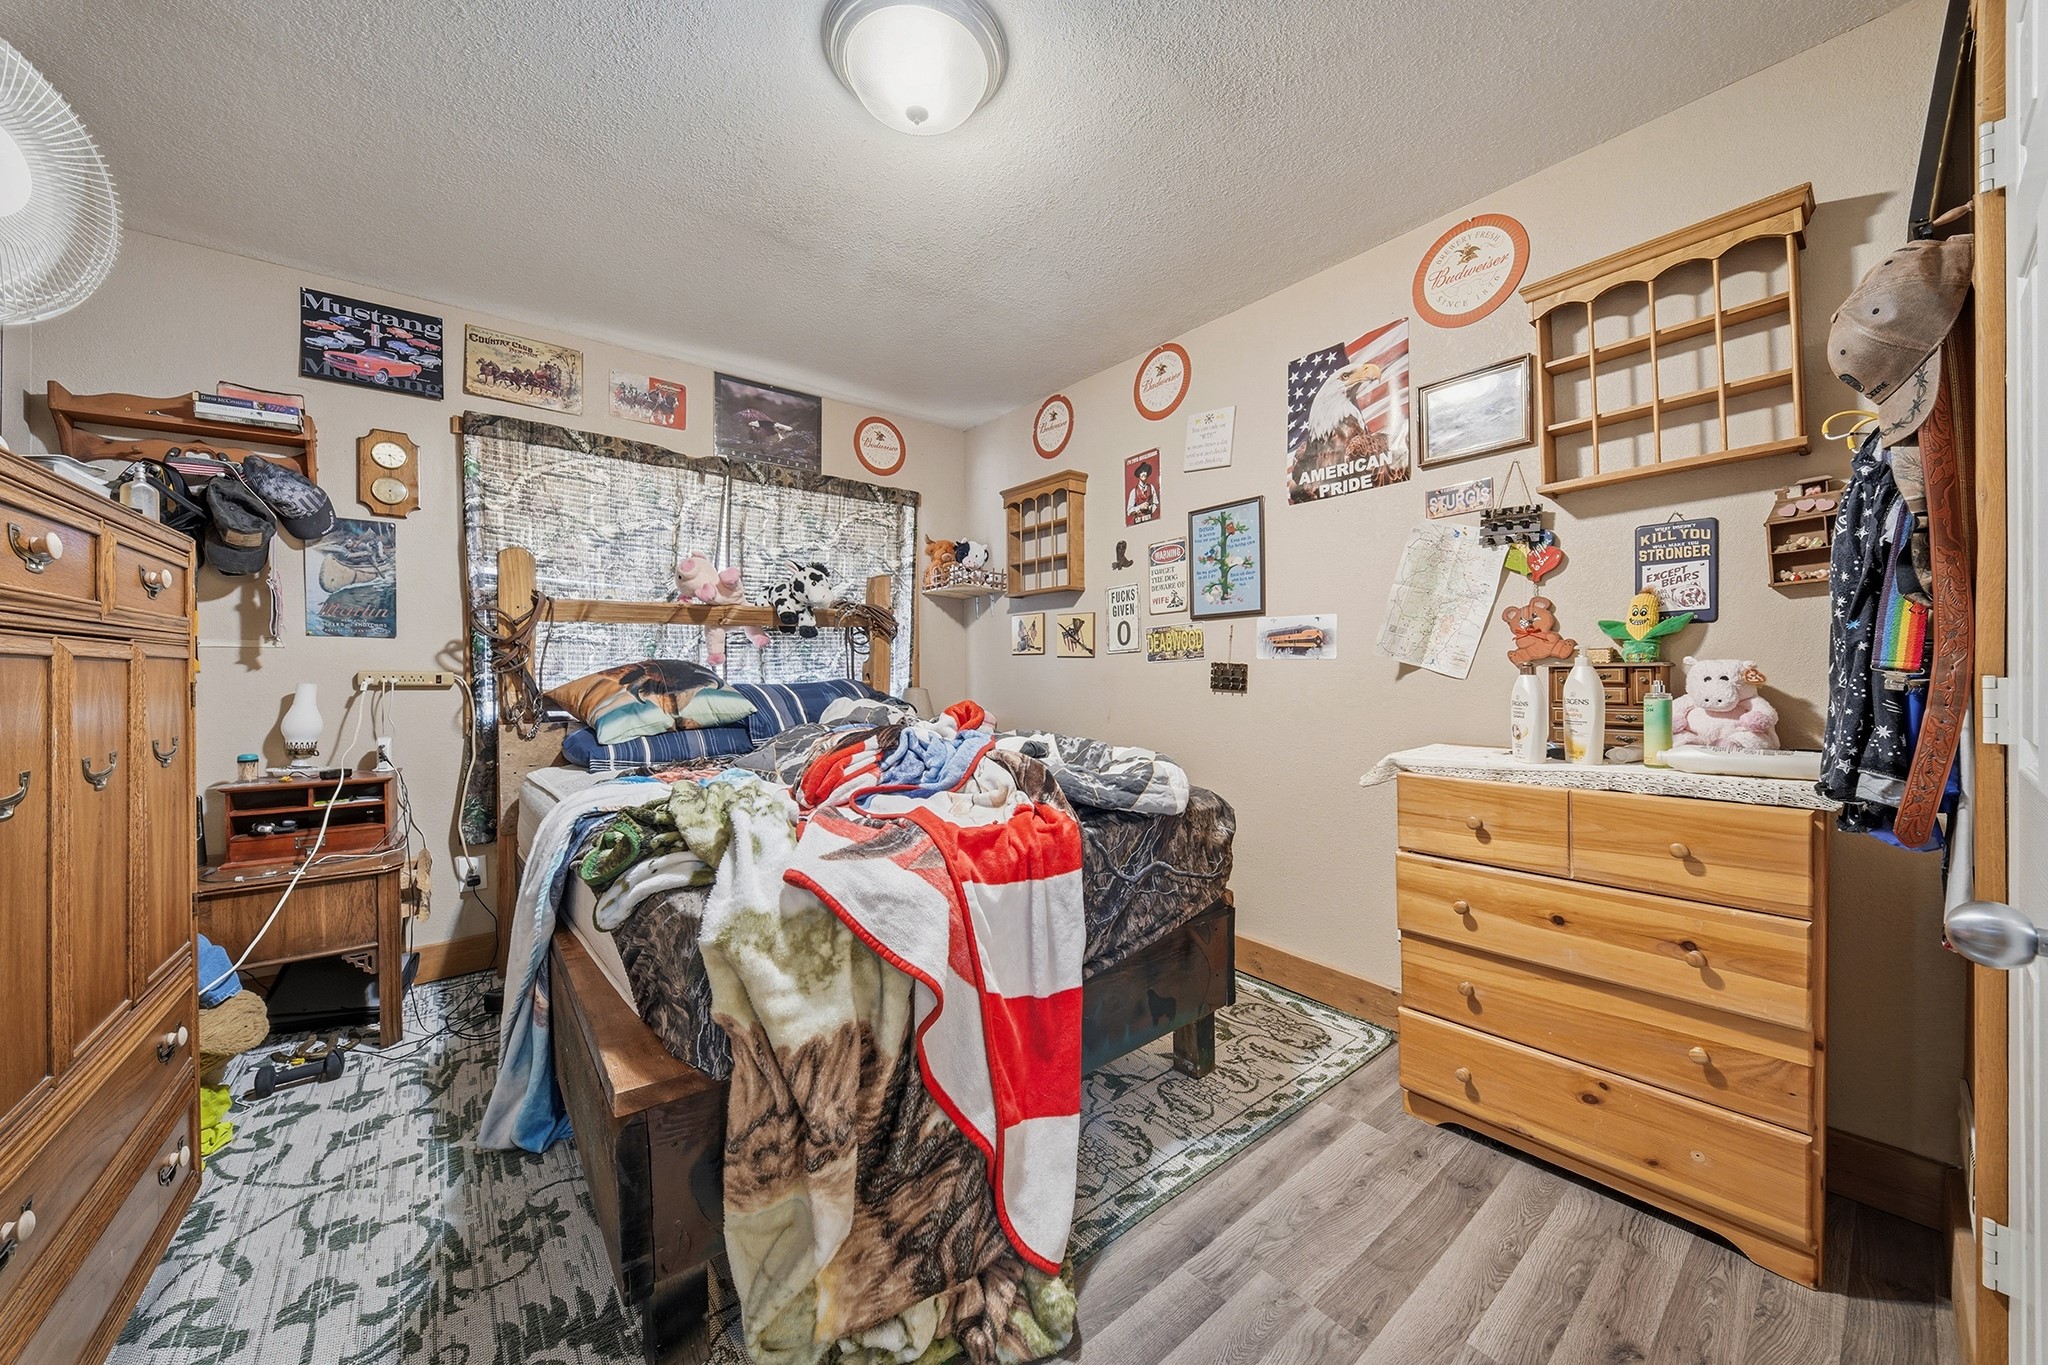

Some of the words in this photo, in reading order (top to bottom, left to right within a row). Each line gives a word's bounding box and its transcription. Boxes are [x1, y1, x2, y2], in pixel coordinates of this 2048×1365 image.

[1436, 234, 1472, 265] BREWERY
[1475, 231, 1501, 243] FRESH
[1428, 253, 1509, 290] Budweiser
[1436, 295, 1468, 308] SINCE
[301, 291, 442, 340] Mustang
[1142, 371, 1182, 393] Budweiser
[1039, 420, 1068, 434] Budweiser
[862, 437, 898, 452] Budweiser
[1299, 452, 1393, 485] AMERICAN
[1318, 474, 1374, 498] PRIDE
[1428, 486, 1492, 513] STURGIS
[1640, 530, 1677, 547] KILL
[1680, 528, 1711, 540] YOU
[1154, 549, 1181, 560] WARNING
[1639, 544, 1711, 562] STRONGER
[1151, 566, 1175, 576] FORGET
[1151, 576, 1163, 584] THE
[1164, 574, 1178, 583] DOG
[1646, 565, 1688, 583] EXCEPT
[1661, 571, 1700, 588] BEARS
[1151, 583, 1175, 593] BEWARE
[1177, 580, 1186, 589] OF
[1111, 588, 1136, 604] FUCKS
[1152, 597, 1169, 605] WIFE
[1112, 602, 1135, 617] GIVEN
[1117, 620, 1131, 646] 0
[1147, 629, 1203, 653] DEADWOOD
